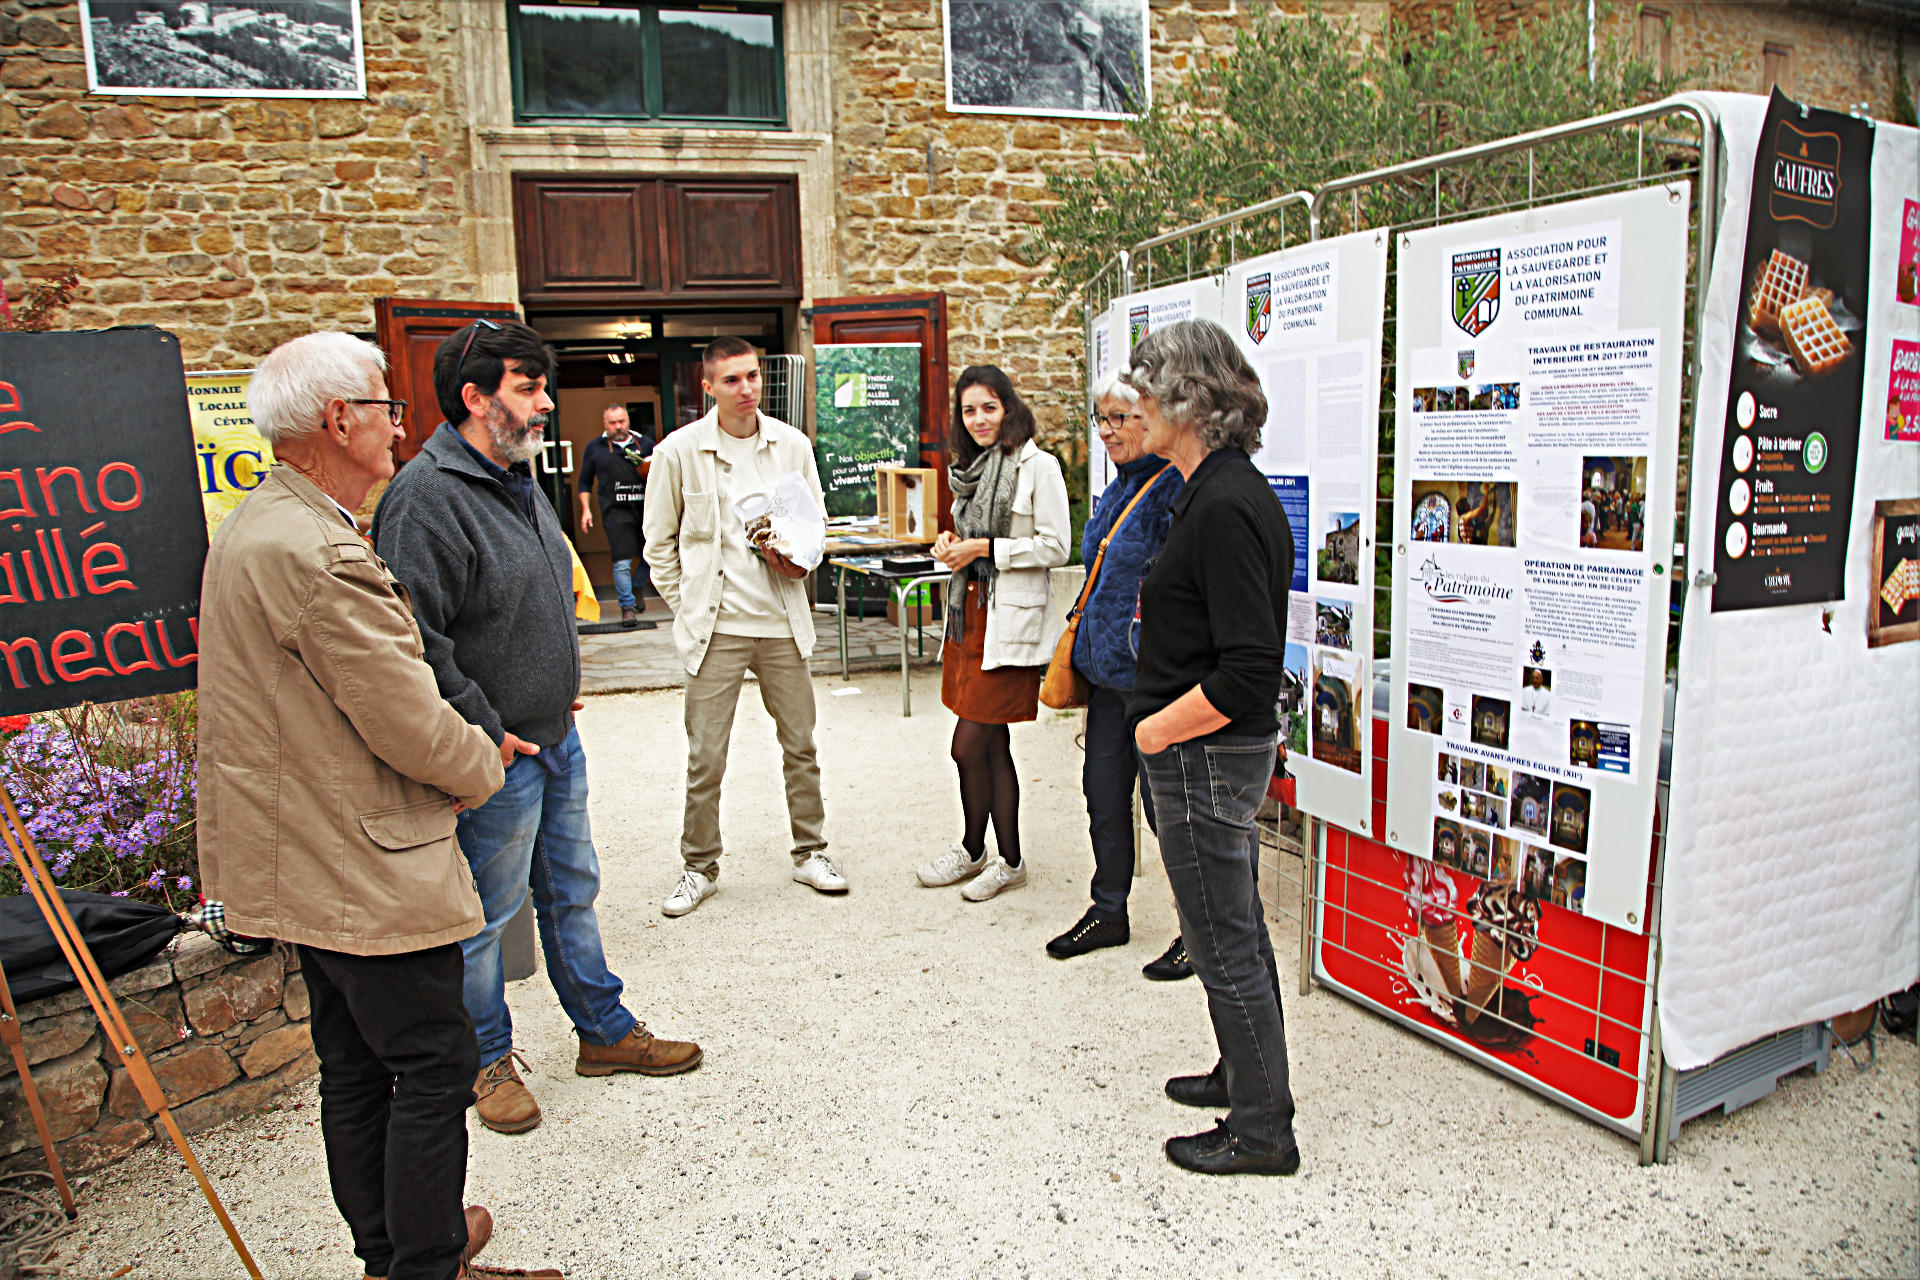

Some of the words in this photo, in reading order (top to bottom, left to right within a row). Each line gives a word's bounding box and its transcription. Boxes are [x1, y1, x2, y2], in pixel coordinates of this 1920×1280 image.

[1774, 159, 1834, 198] GAUFRES
[1507, 241, 1573, 261] ASSOCIATION
[1577, 236, 1607, 250] POUR
[1274, 267, 1309, 281] ASSOCIATION
[1311, 262, 1330, 273] POUR
[1454, 260, 1498, 273] PATRIMOINE
[1506, 264, 1518, 276] LA
[1522, 255, 1591, 274] SAUVEGARDE
[1595, 253, 1608, 264] ET
[1274, 287, 1280, 295] LA
[1282, 277, 1320, 292] SAUVEGARDE
[1323, 275, 1330, 284] ET
[1510, 280, 1522, 291] LA
[1526, 271, 1601, 289] VALORISATION
[1276, 299, 1282, 307] LA
[1284, 289, 1327, 304] VALORISATION
[1515, 295, 1528, 306] DU
[1532, 287, 1595, 304] PATRIMOINE
[1151, 302, 1178, 313] ASSOCIATION
[1179, 299, 1191, 307] POUR
[1279, 310, 1285, 319] DU
[1287, 303, 1323, 318] PATRIMOINE
[1524, 306, 1583, 321] COMMUNAL
[1158, 312, 1185, 324] SAUVEGARDE
[1186, 310, 1191, 318] ET
[1283, 318, 1316, 330] COMMUNAL
[1529, 346, 1567, 355] TRAVAUX
[1570, 344, 1581, 352] DE
[1584, 338, 1655, 351] RESTAURATION
[1533, 355, 1584, 365] INTERIEURE
[1602, 351, 1648, 360] 2017/2018
[860, 374, 894, 382] SYNDICAT
[860, 390, 889, 398] VALLÉES
[1759, 404, 1778, 419] Sucre
[1758, 436, 1773, 450] Pâte
[1773, 437, 1778, 451] à
[1779, 437, 1802, 451] tartiner
[855, 448, 895, 462] objectifs
[832, 467, 847, 477] pour
[834, 475, 861, 485] vivant
[1755, 479, 1773, 493] Fruits
[1752, 521, 1788, 536] Gourmande
[1525, 560, 1571, 570] OPÉRATION
[1574, 564, 1584, 572] DE
[1587, 565, 1644, 577] PARRAINAGE
[1446, 570, 1455, 580] les
[1456, 572, 1479, 582] rubans
[1481, 575, 1490, 583] du
[1434, 577, 1513, 600] Patrimoine
[1446, 741, 1479, 755] TRAVAUX
[1481, 750, 1530, 767] AVANT/APRES
[1533, 763, 1561, 774] EGLISE
